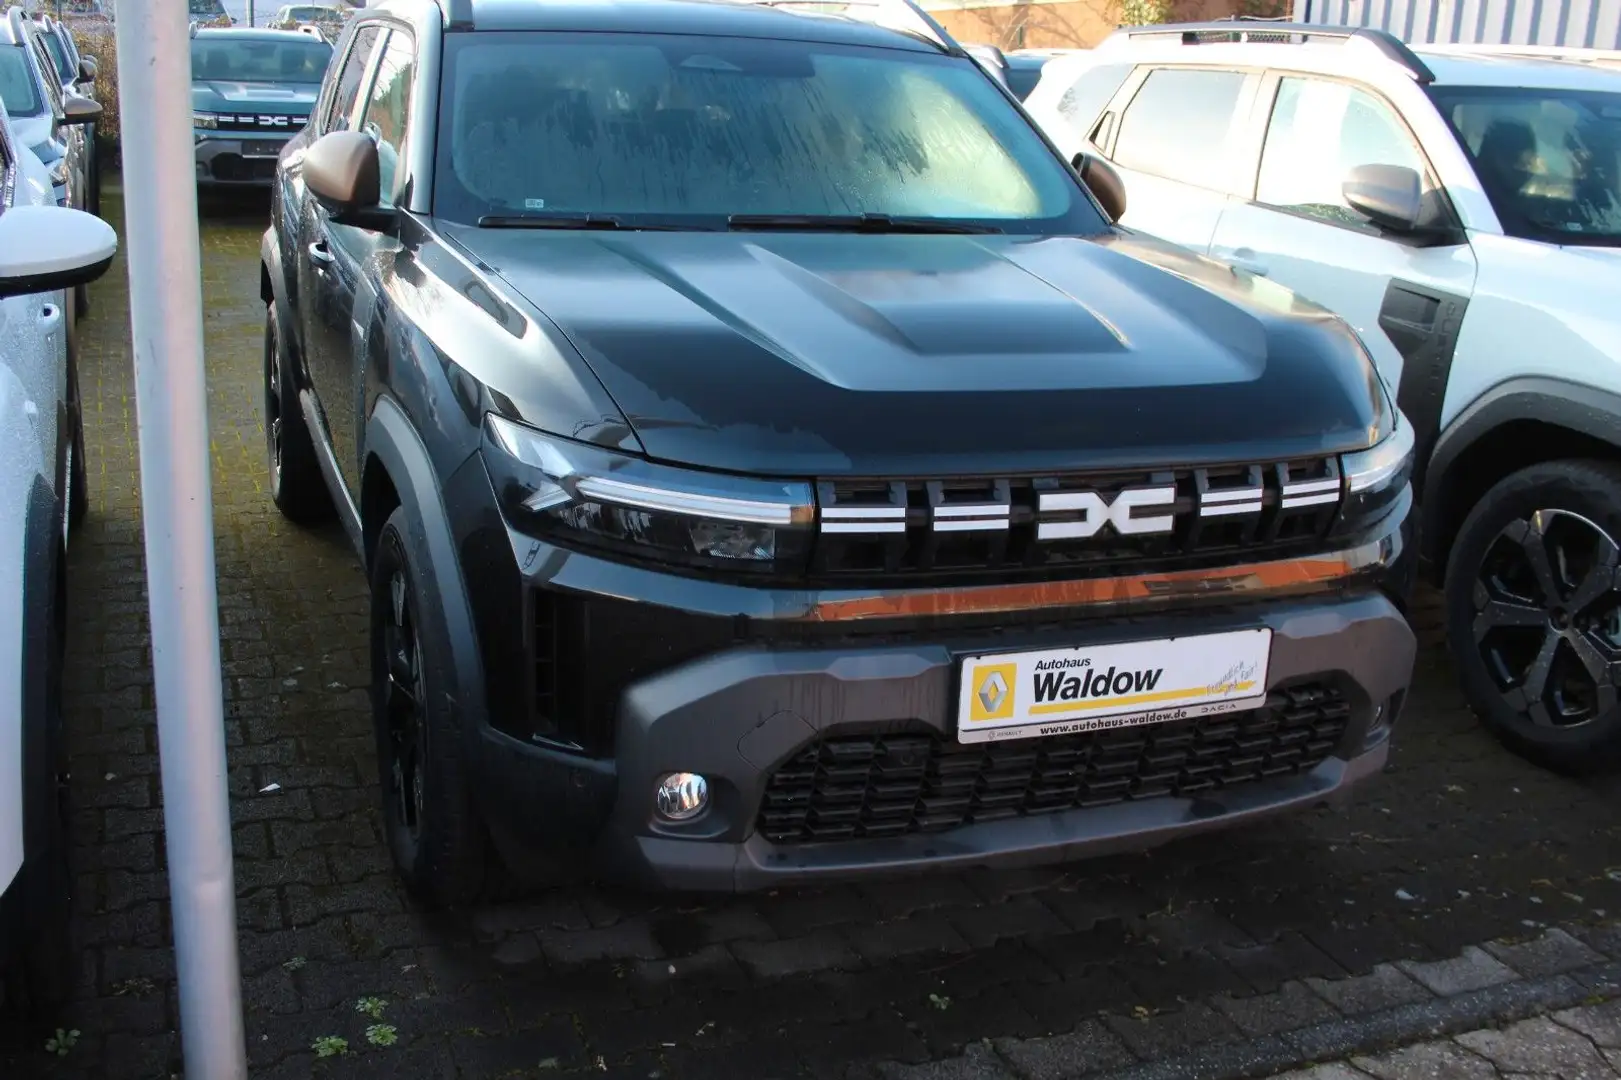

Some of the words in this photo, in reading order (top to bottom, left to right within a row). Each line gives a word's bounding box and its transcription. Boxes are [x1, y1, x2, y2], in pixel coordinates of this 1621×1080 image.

[1034, 656, 1092, 671] Autohaus
[1033, 666, 1163, 703] Waldow
[1040, 709, 1187, 735] www.autohaus-waldow.de
[1200, 703, 1236, 712] DACIA
